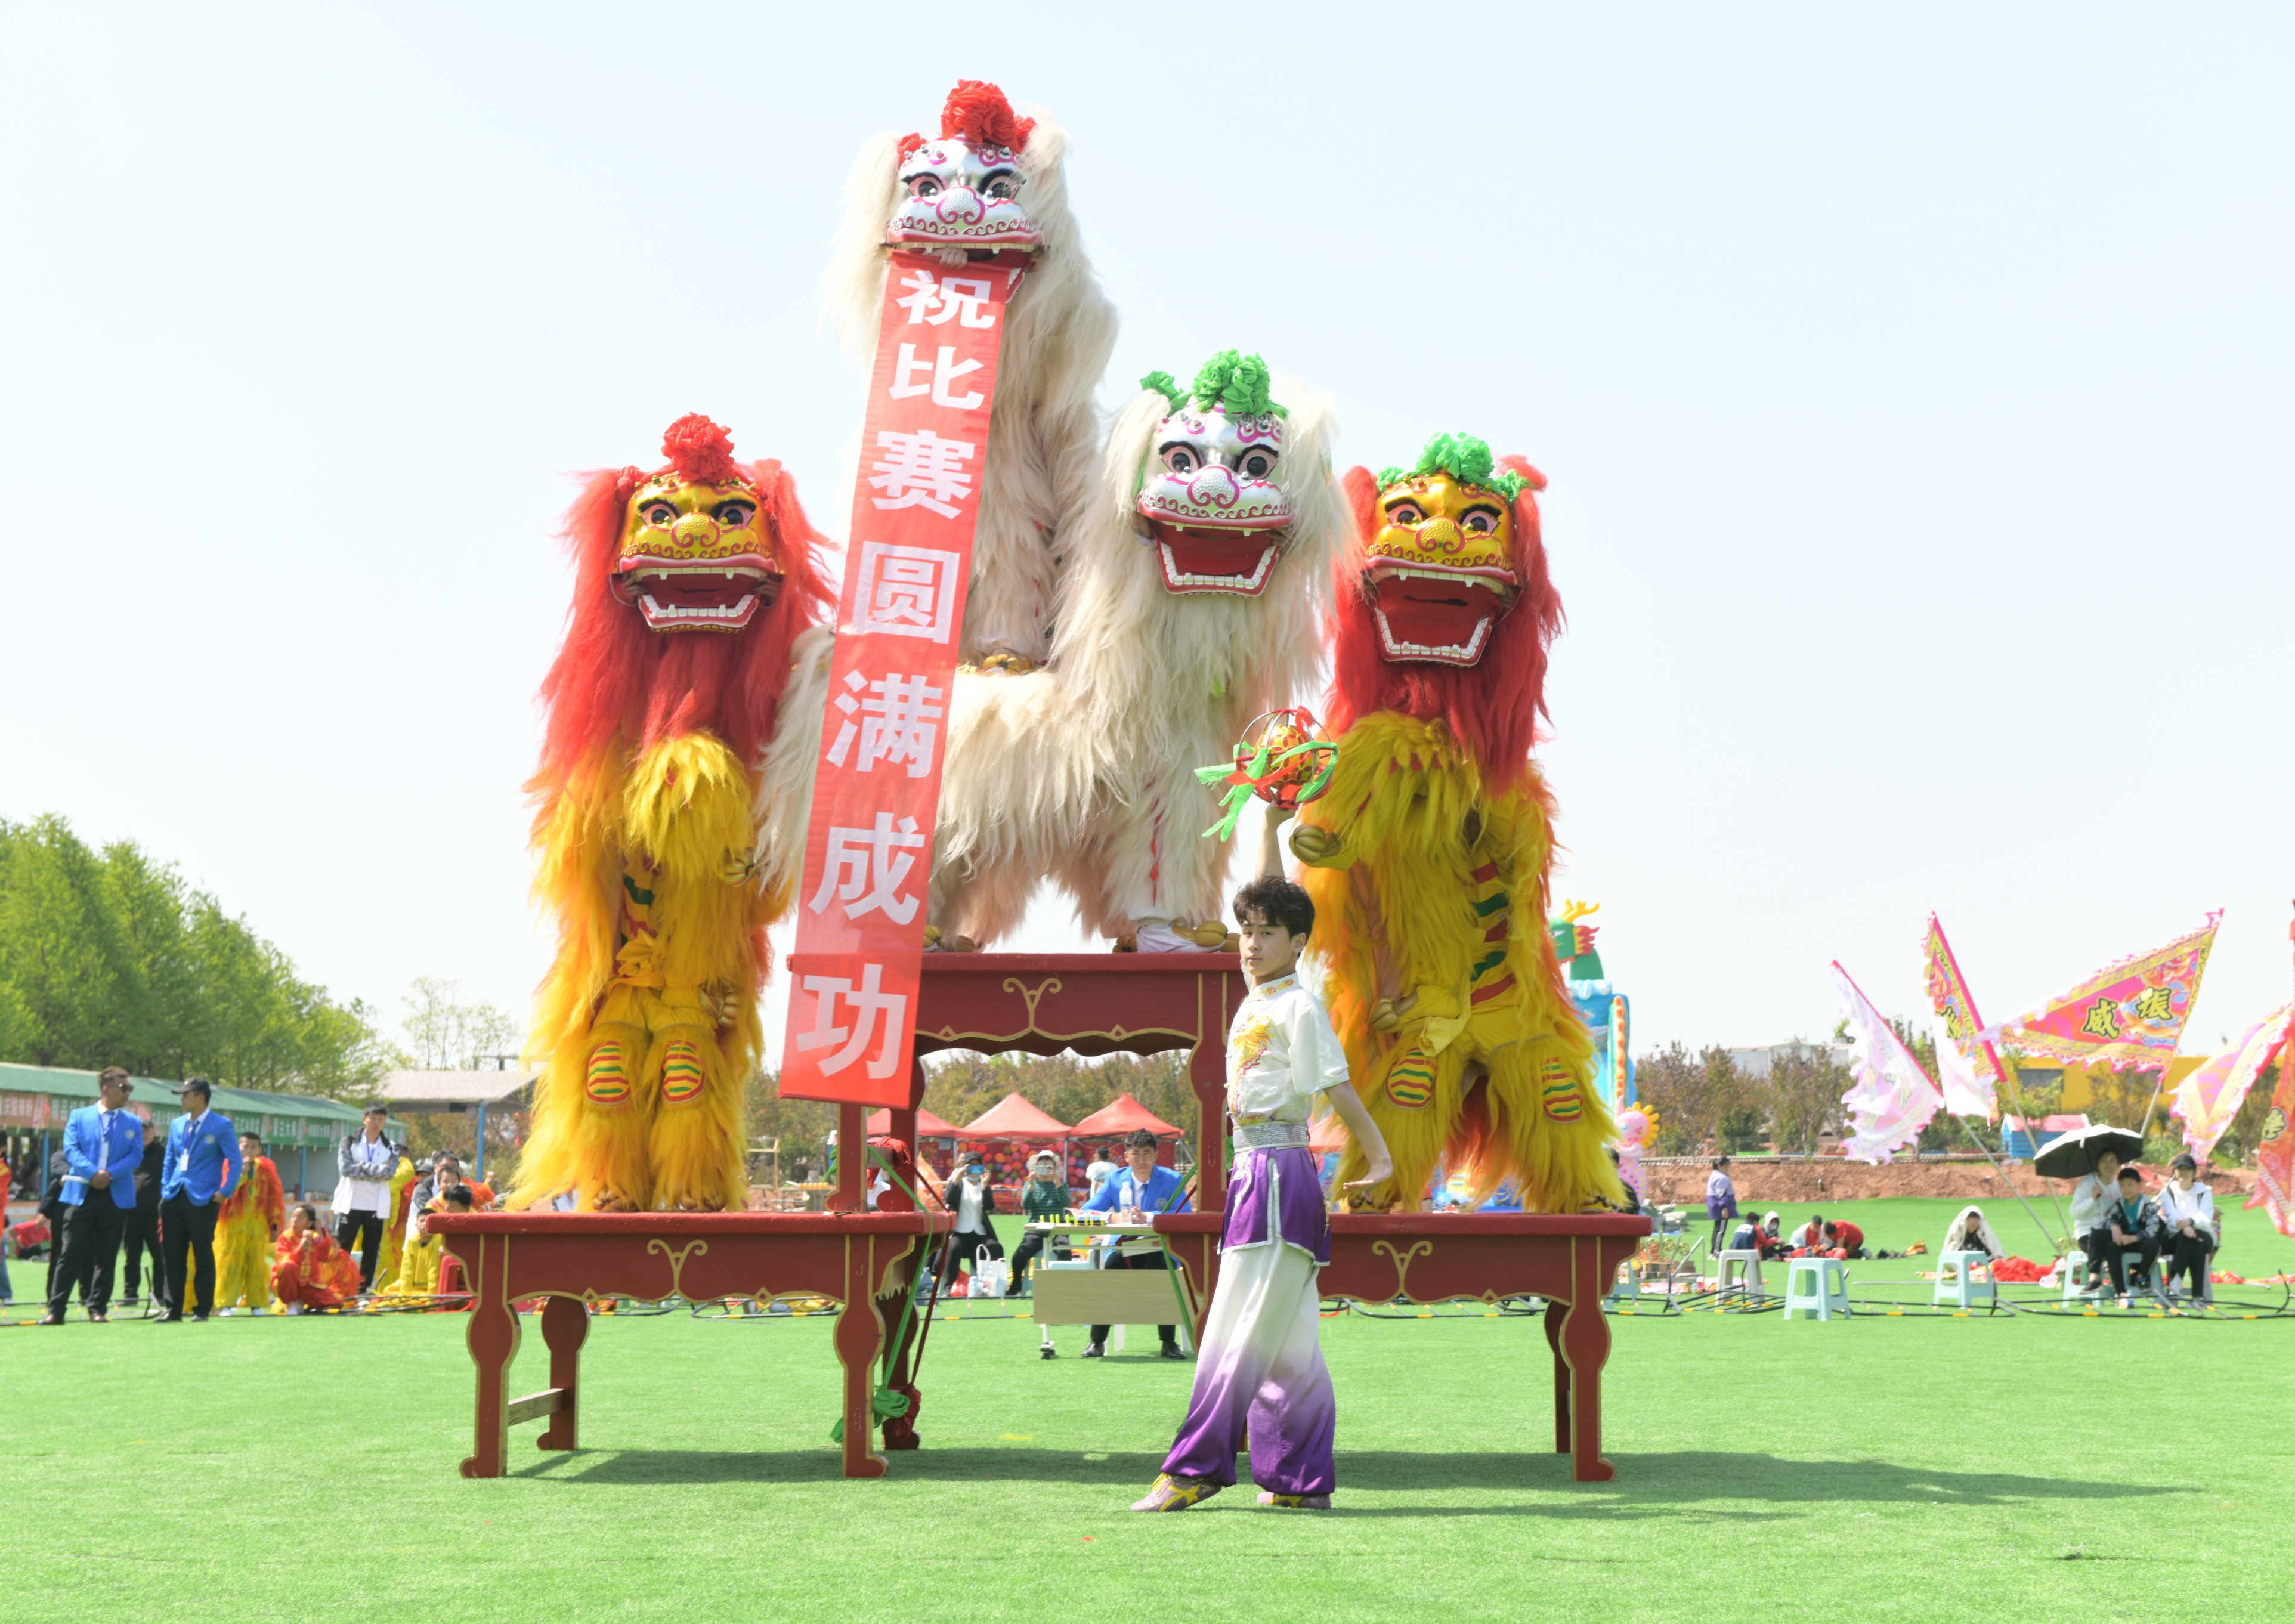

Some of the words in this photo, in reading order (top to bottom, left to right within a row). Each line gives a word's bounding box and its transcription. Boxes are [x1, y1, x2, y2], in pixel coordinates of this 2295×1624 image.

[796, 270, 996, 1079] 祝比赛圆满成功
